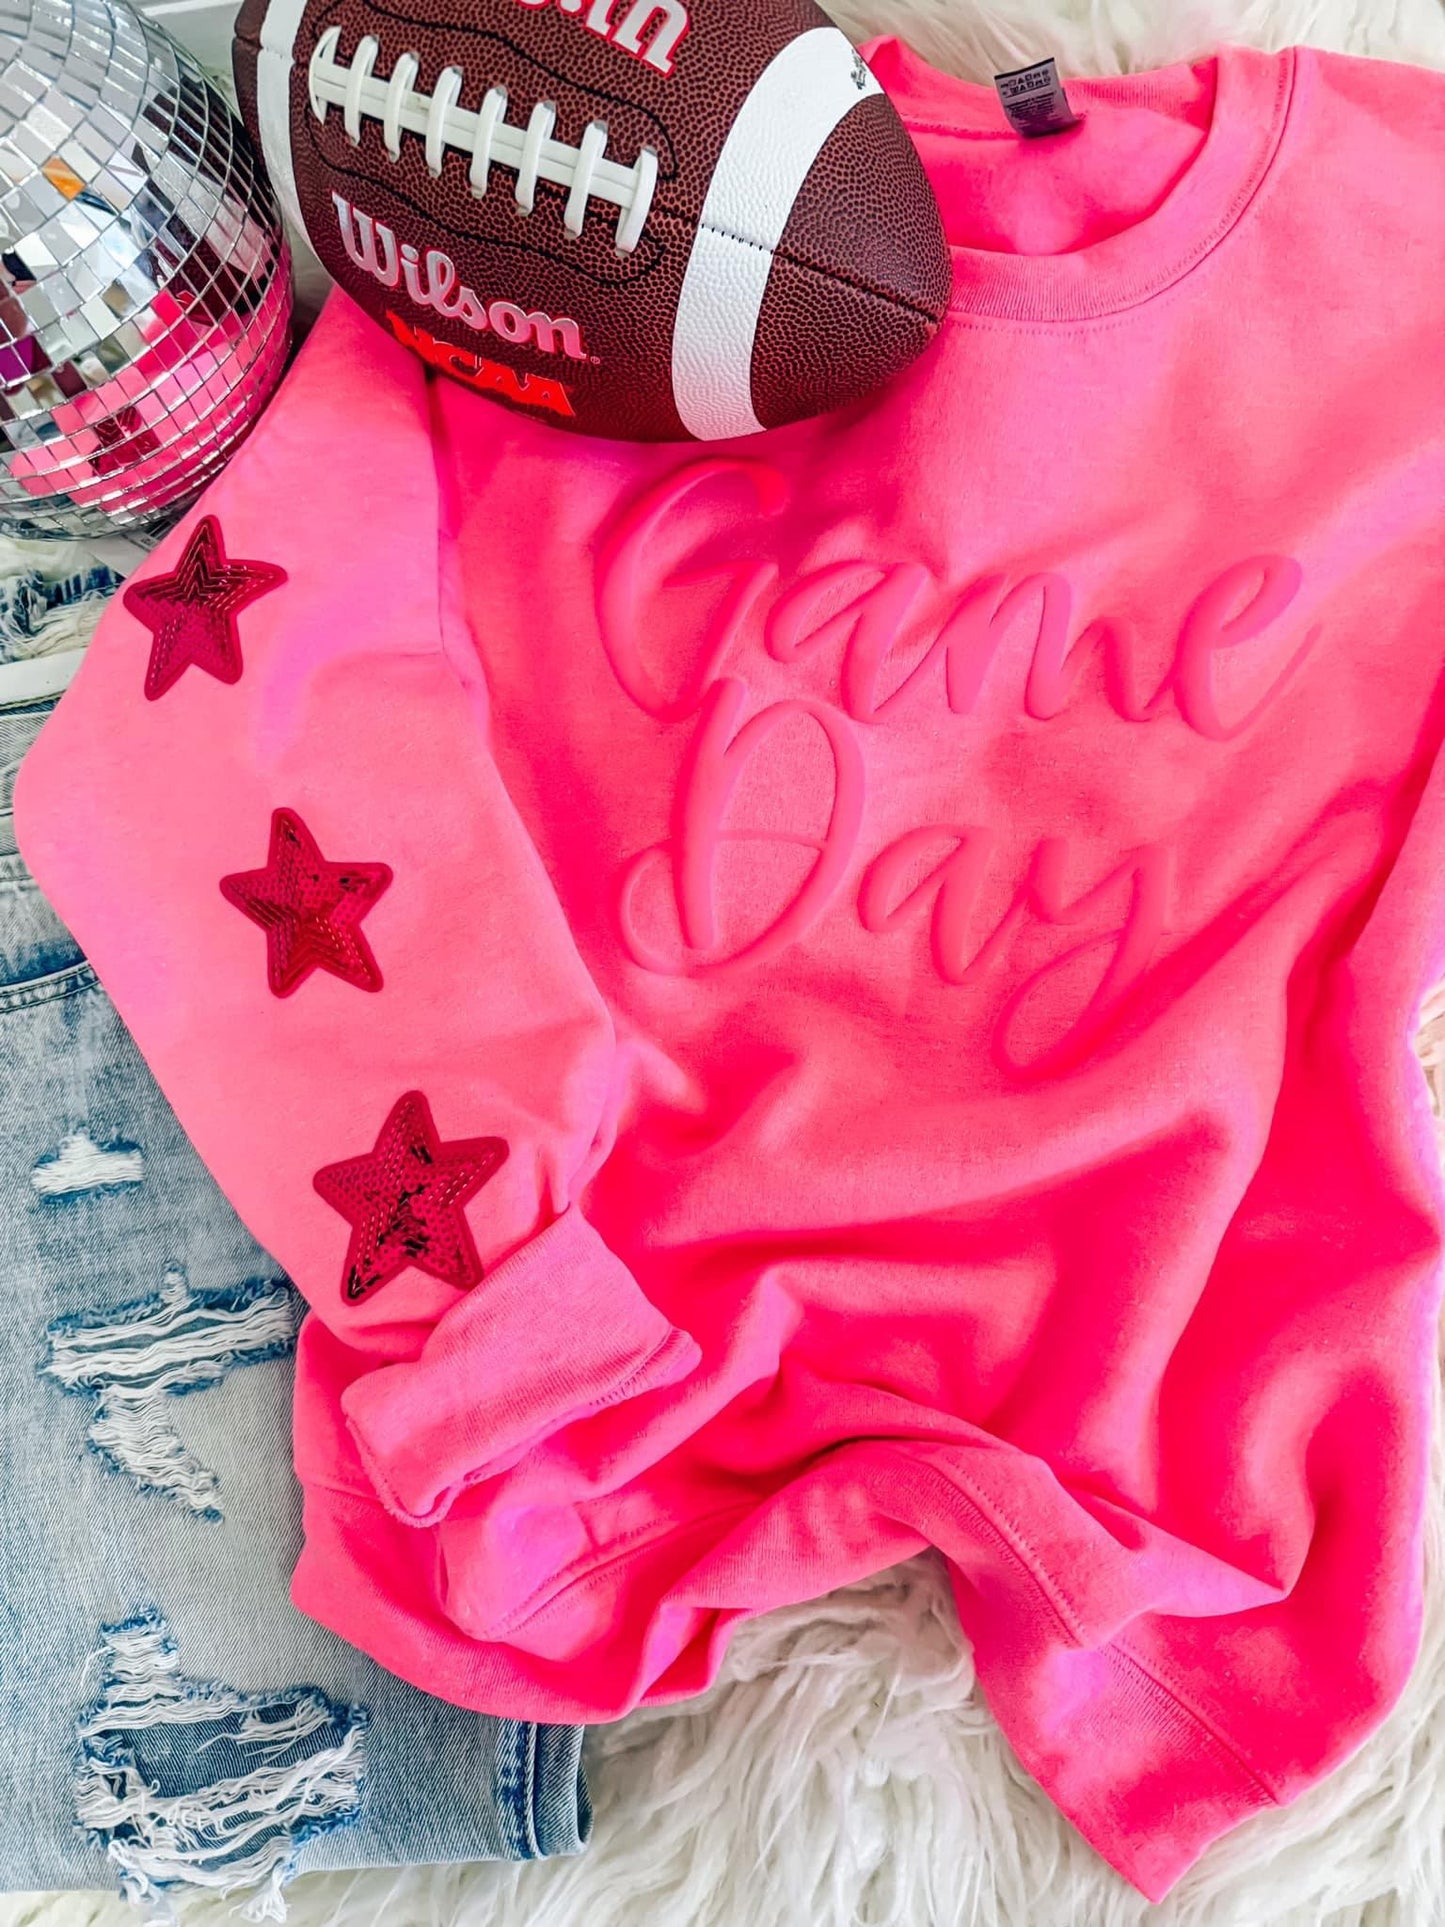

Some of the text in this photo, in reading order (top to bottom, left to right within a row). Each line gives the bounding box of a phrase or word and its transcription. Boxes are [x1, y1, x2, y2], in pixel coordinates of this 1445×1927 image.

[331, 189, 588, 360] Wilson
[595, 458, 1323, 741] Game
[619, 677, 1172, 1079] Day
